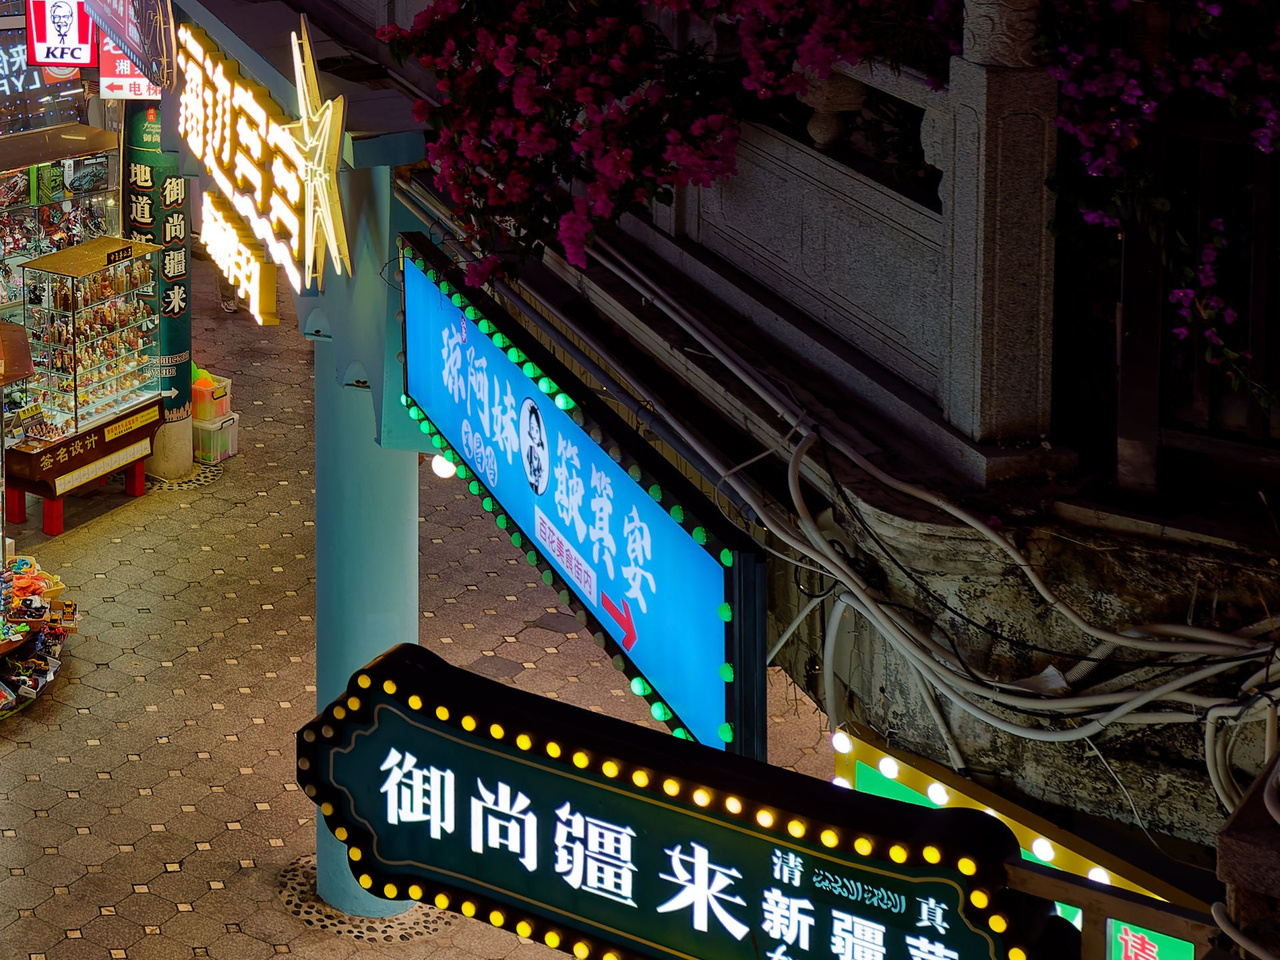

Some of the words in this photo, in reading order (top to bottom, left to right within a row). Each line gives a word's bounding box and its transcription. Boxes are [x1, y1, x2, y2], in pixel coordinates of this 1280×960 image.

[45, 46, 82, 60] KFC
[128, 81, 161, 97] 电梯
[162, 176, 187, 314] 御尚疆来
[40, 432, 99, 472] 签名设计
[537, 514, 594, 598] 百花美食街内
[379, 746, 750, 942] 御尚疆来
[771, 848, 805, 887] 清
[915, 896, 951, 936] 真
